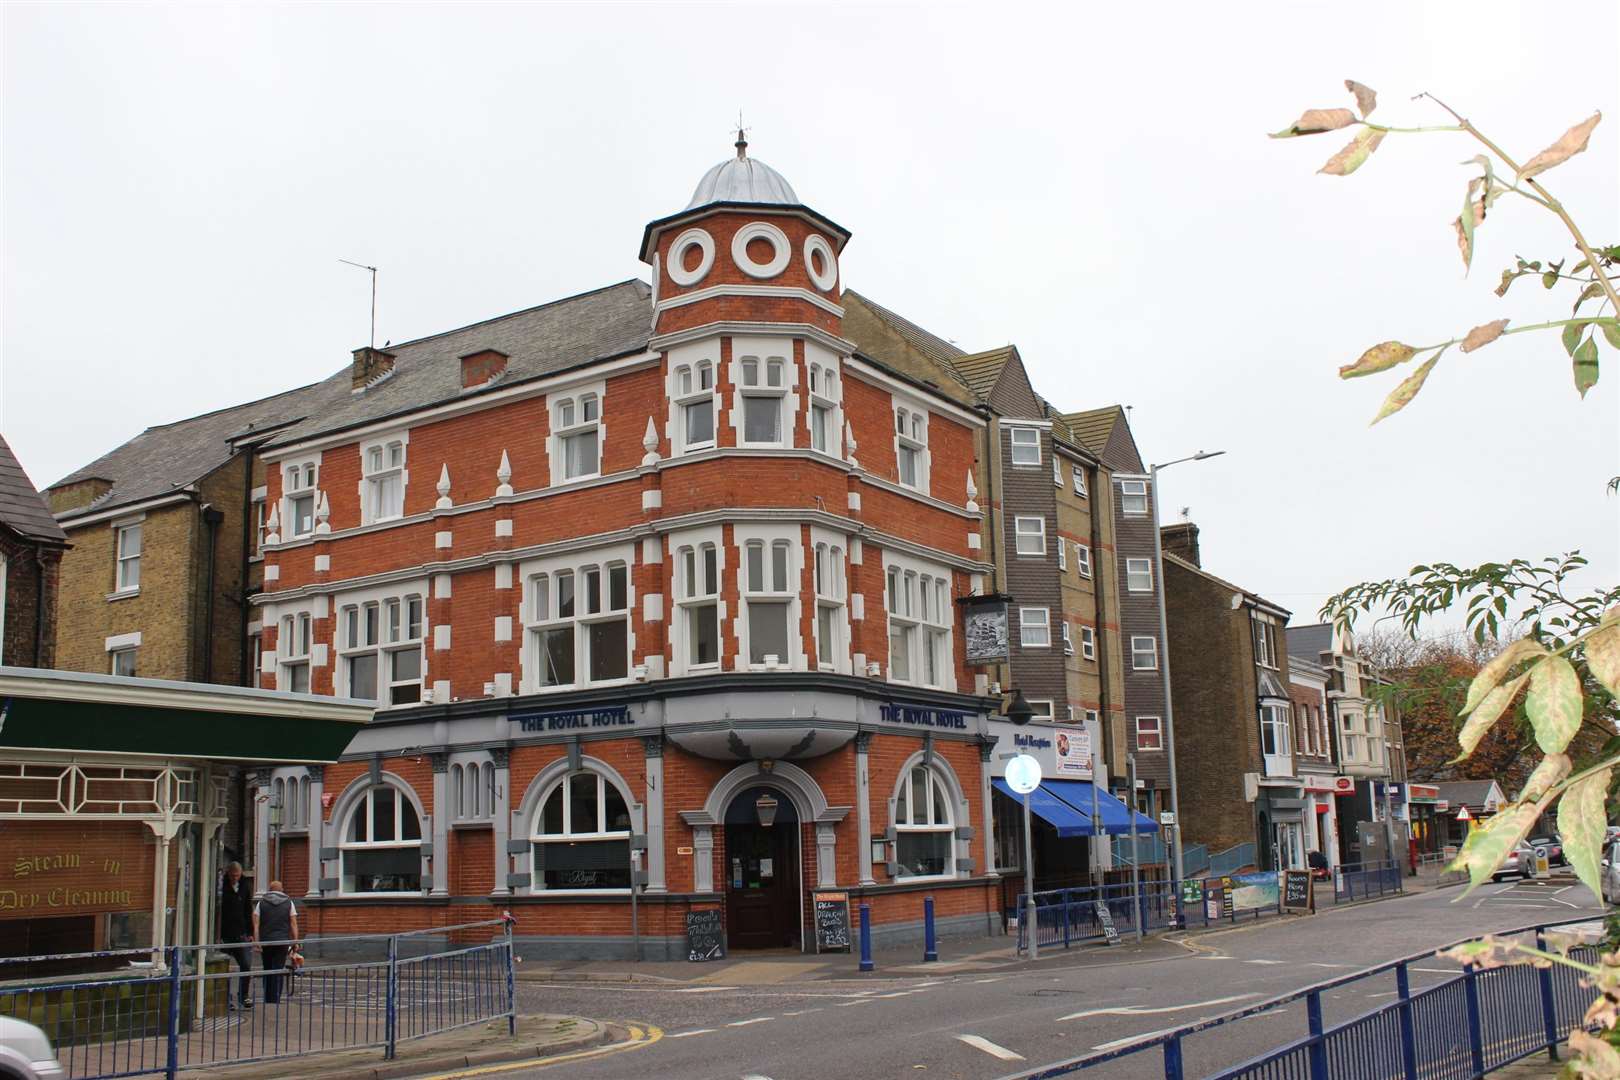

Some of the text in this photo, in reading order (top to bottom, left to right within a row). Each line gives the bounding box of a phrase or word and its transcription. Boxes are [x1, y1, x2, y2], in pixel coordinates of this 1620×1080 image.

[521, 711, 635, 732] THE ROYAL HOTEL
[880, 706, 967, 729] THE ROYAL HOTEL
[14, 854, 81, 878] Steam
[0, 887, 131, 909] Dry Cleaning
